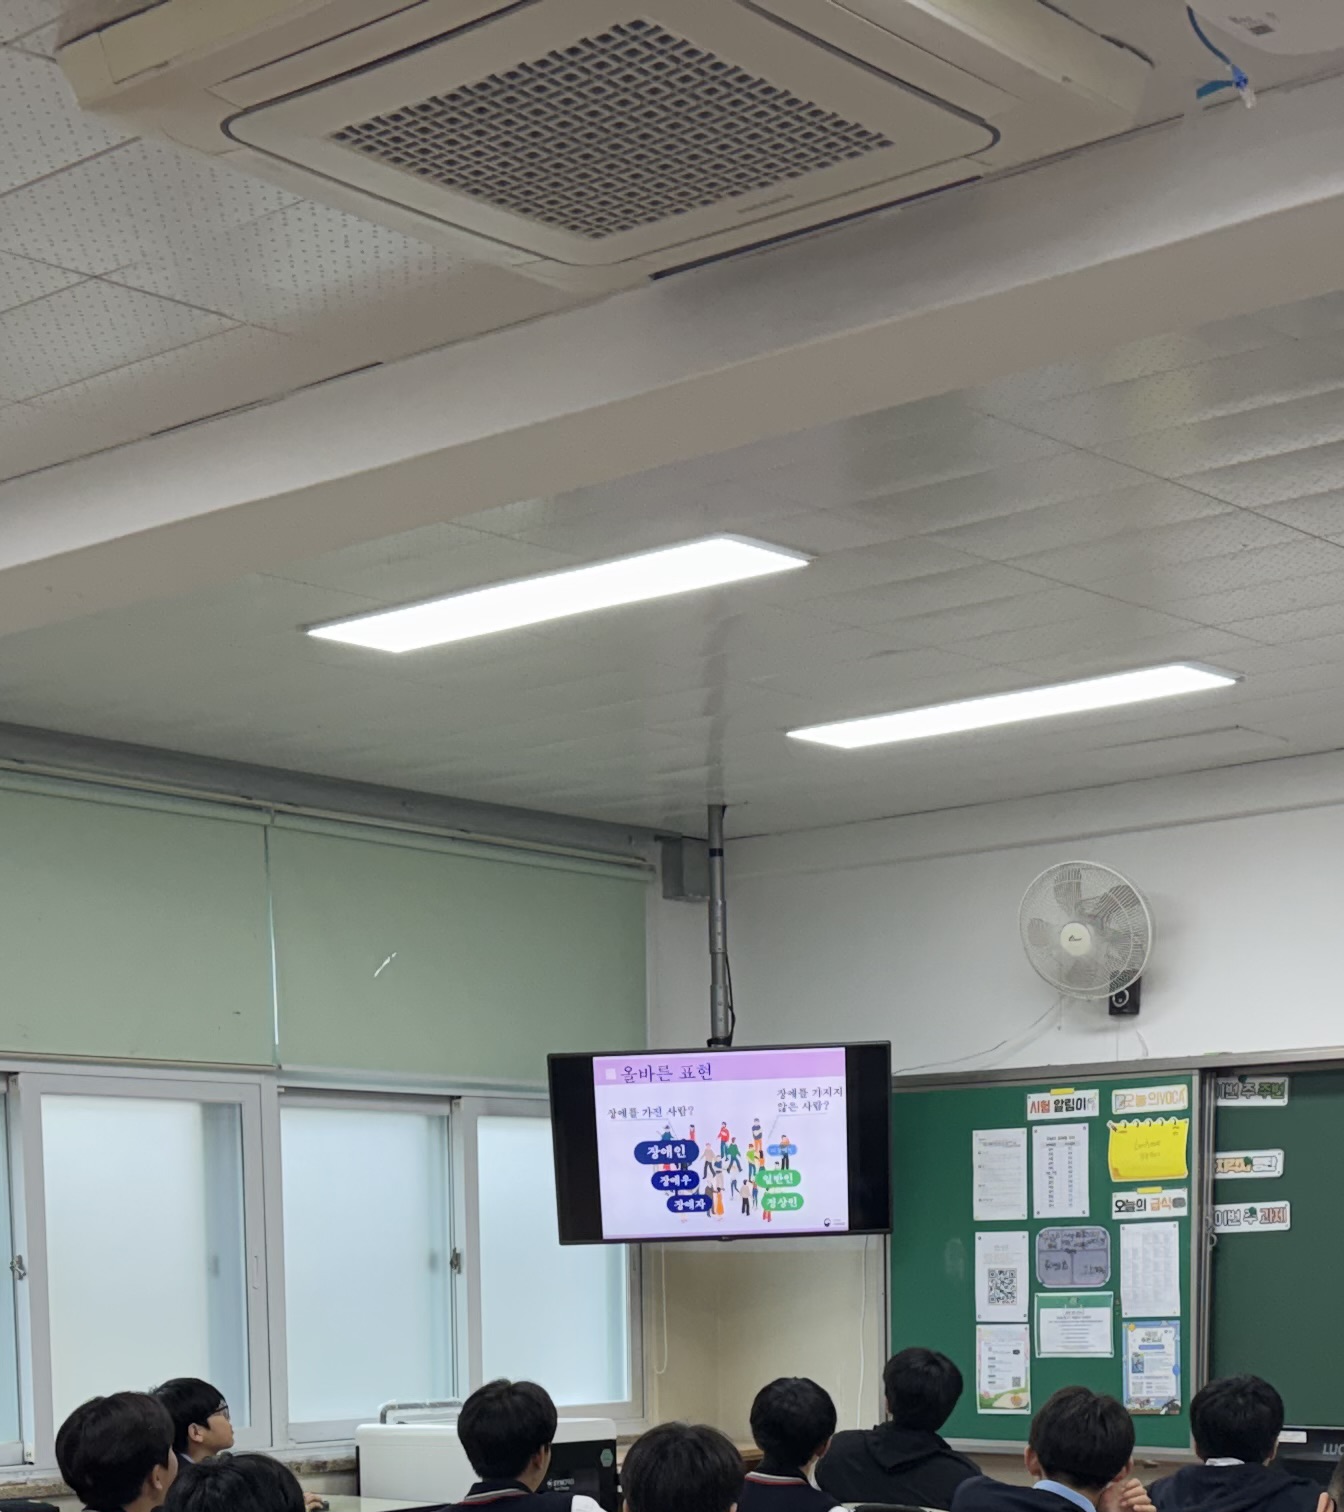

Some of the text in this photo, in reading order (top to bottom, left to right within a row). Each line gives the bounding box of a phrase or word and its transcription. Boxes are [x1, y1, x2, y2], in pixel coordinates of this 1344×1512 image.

[621, 1062, 712, 1084] 올바른 표현
[647, 1144, 687, 1160] 장애인
[1114, 1198, 1147, 1213] 오늘의
[1215, 1208, 1241, 1226] 이번
